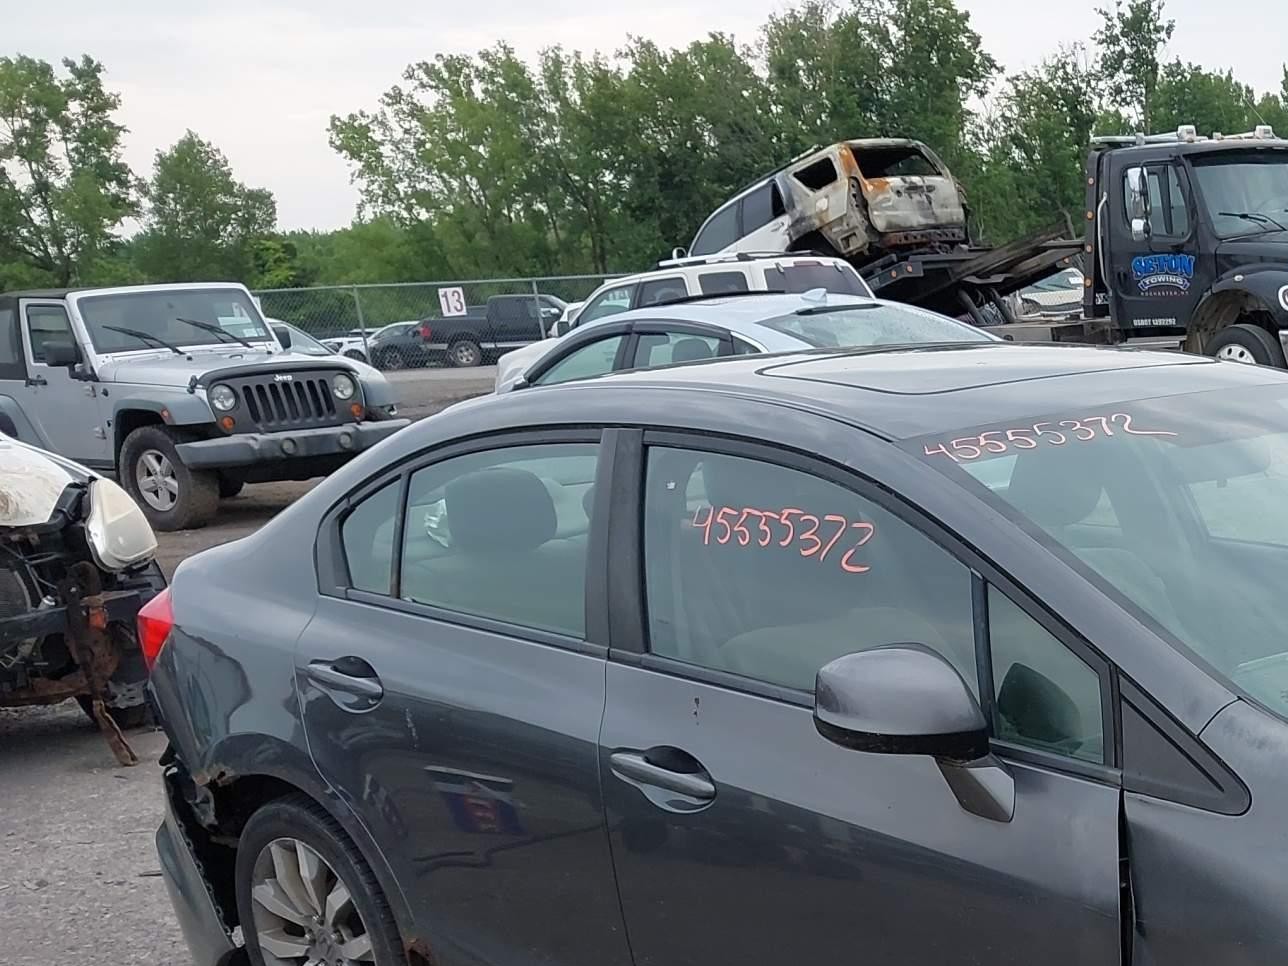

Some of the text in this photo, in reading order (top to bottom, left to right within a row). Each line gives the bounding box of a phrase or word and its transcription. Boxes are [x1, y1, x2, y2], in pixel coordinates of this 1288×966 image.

[1132, 254, 1195, 279] SETON
[1143, 275, 1184, 284] TOWING
[440, 290, 464, 313] 13
[923, 412, 1180, 463] 45555372
[691, 503, 876, 573] 45555372
